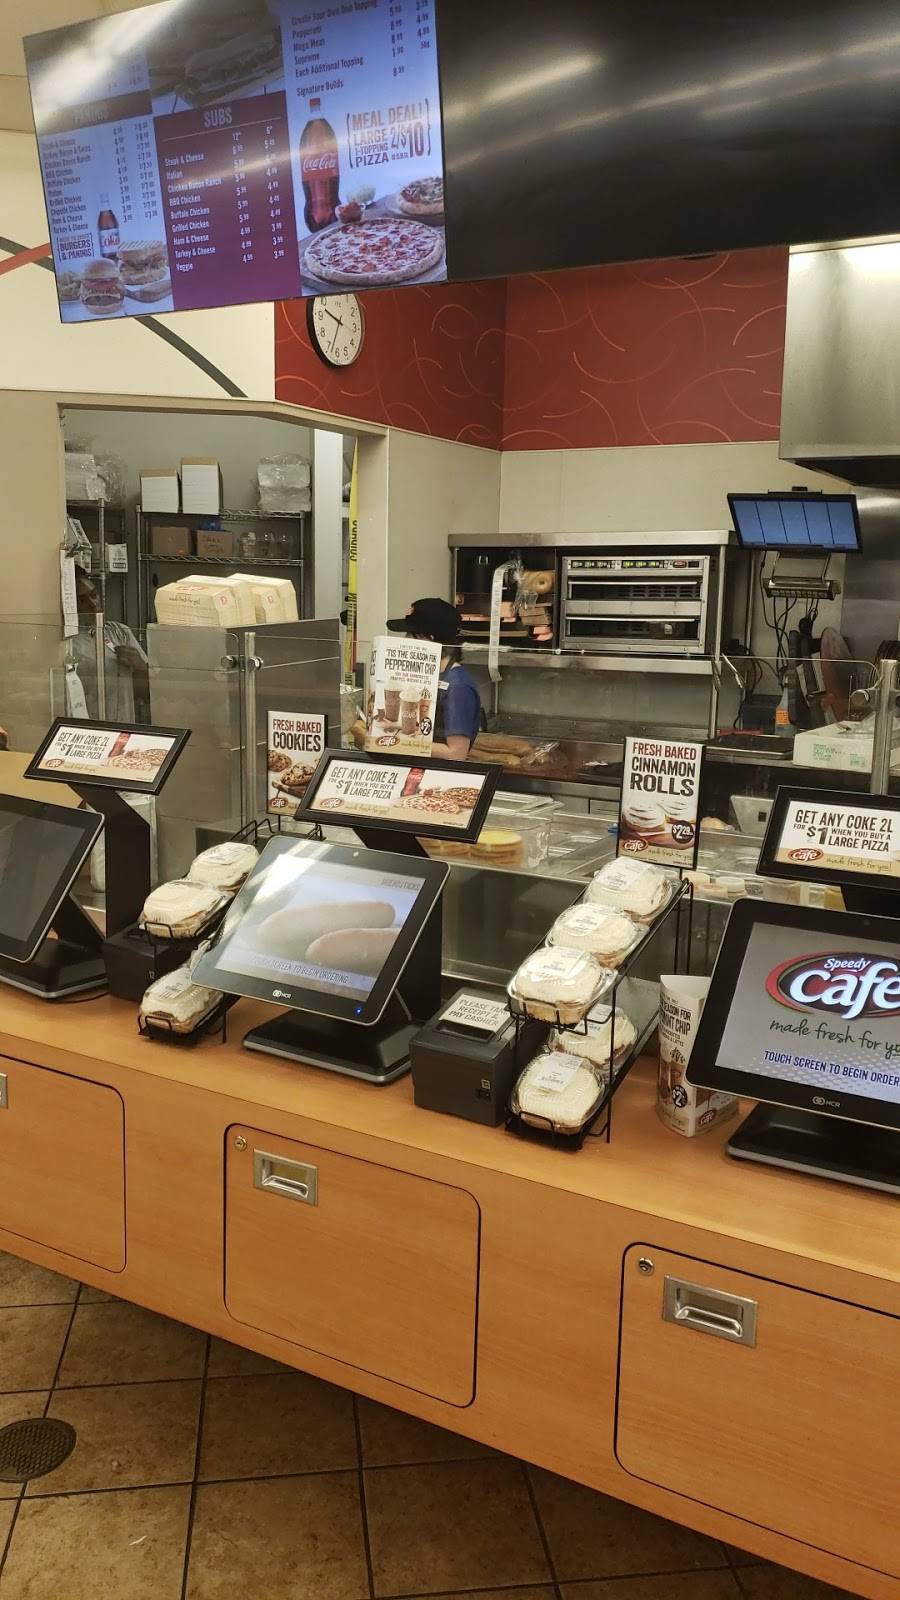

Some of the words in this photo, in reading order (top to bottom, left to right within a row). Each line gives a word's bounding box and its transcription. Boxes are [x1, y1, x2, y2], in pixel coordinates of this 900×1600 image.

[296, 68, 310, 78] Each
[310, 61, 340, 74] Additional
[341, 56, 364, 67] Topping
[297, 84, 324, 97] Signature
[325, 80, 344, 91] Builds
[204, 107, 232, 128] SUBS
[352, 110, 384, 130] MEAL
[388, 102, 423, 125] DEAL!
[353, 129, 389, 146] LARGE
[355, 142, 388, 156] 1-TOPPING
[355, 152, 389, 167] PIZZA
[180, 195, 201, 204] Chicken
[171, 210, 189, 220] Buffalo
[189, 207, 210, 217] Chicken
[172, 223, 189, 233] Grilled
[189, 221, 209, 230] Chicken
[60, 239, 91, 252] BURGERS
[173, 237, 185, 246] Ham
[191, 234, 209, 243] Cheese
[175, 249, 192, 259] Turkey
[198, 247, 216, 256] Cheese
[176, 263, 193, 273] Veggie
[318, 311, 324, 321] 9
[350, 307, 355, 317] 2
[320, 328, 326, 338] 8
[352, 322, 357, 333] 3
[326, 341, 331, 350] 7
[349, 338, 355, 346] 4
[335, 348, 340, 358] 6
[343, 347, 348, 357] 5
[398, 650, 409, 660] THE
[410, 651, 428, 662] SEASON
[385, 658, 424, 673] PEPPERMINT
[424, 662, 437, 675] CHIP
[273, 719, 294, 732] FRESH
[296, 720, 322, 734] BAKED
[58, 732, 72, 742] GET
[273, 732, 322, 752] COOKIES
[61, 743, 74, 756] $1
[633, 742, 662, 757] FRESH
[664, 745, 697, 760] BAKED
[632, 756, 696, 778] CINNAMON
[331, 766, 348, 779] GET
[347, 767, 366, 781] ANY
[366, 770, 389, 784] COKE
[388, 772, 399, 785] 2L
[336, 779, 353, 795] $1
[630, 772, 694, 797] ROLLS
[350, 787, 371, 798] LARGE
[372, 789, 393, 800] PIZZA
[795, 809, 818, 824] GET
[819, 812, 844, 828] ANY
[846, 815, 878, 831] COKE
[879, 818, 894, 833] 2L
[806, 826, 829, 845] $1
[831, 828, 852, 837] WHEN
[854, 830, 868, 838] YOU
[870, 832, 884, 840] BUY
[828, 836, 859, 849] LARGE
[861, 839, 890, 853] PIZZA
[827, 857, 845, 865] made
[847, 858, 865, 868] fresh
[273, 960, 293, 972] SCREEN
[293, 965, 301, 975] TO
[301, 966, 320, 978] BEGIN
[319, 969, 349, 984] ORDERING
[824, 957, 871, 973] Speedy
[790, 962, 900, 1020] Cafe
[459, 999, 489, 1009] PLEASE
[448, 1010, 466, 1018] PAY
[464, 1014, 500, 1027] CASHIER
[458, 1005, 491, 1018] RECEIPT
[681, 1009, 692, 1021] FOR
[675, 1018, 691, 1036] CHIP
[769, 1019, 811, 1036] made
[815, 1022, 856, 1044] fresh
[859, 1030, 882, 1050] for
[764, 1050, 792, 1065] TOUCH
[794, 1056, 827, 1073] SCREEN
[829, 1063, 841, 1075] TO
[842, 1066, 869, 1081] BEGIN
[826, 1100, 841, 1108] NCR
